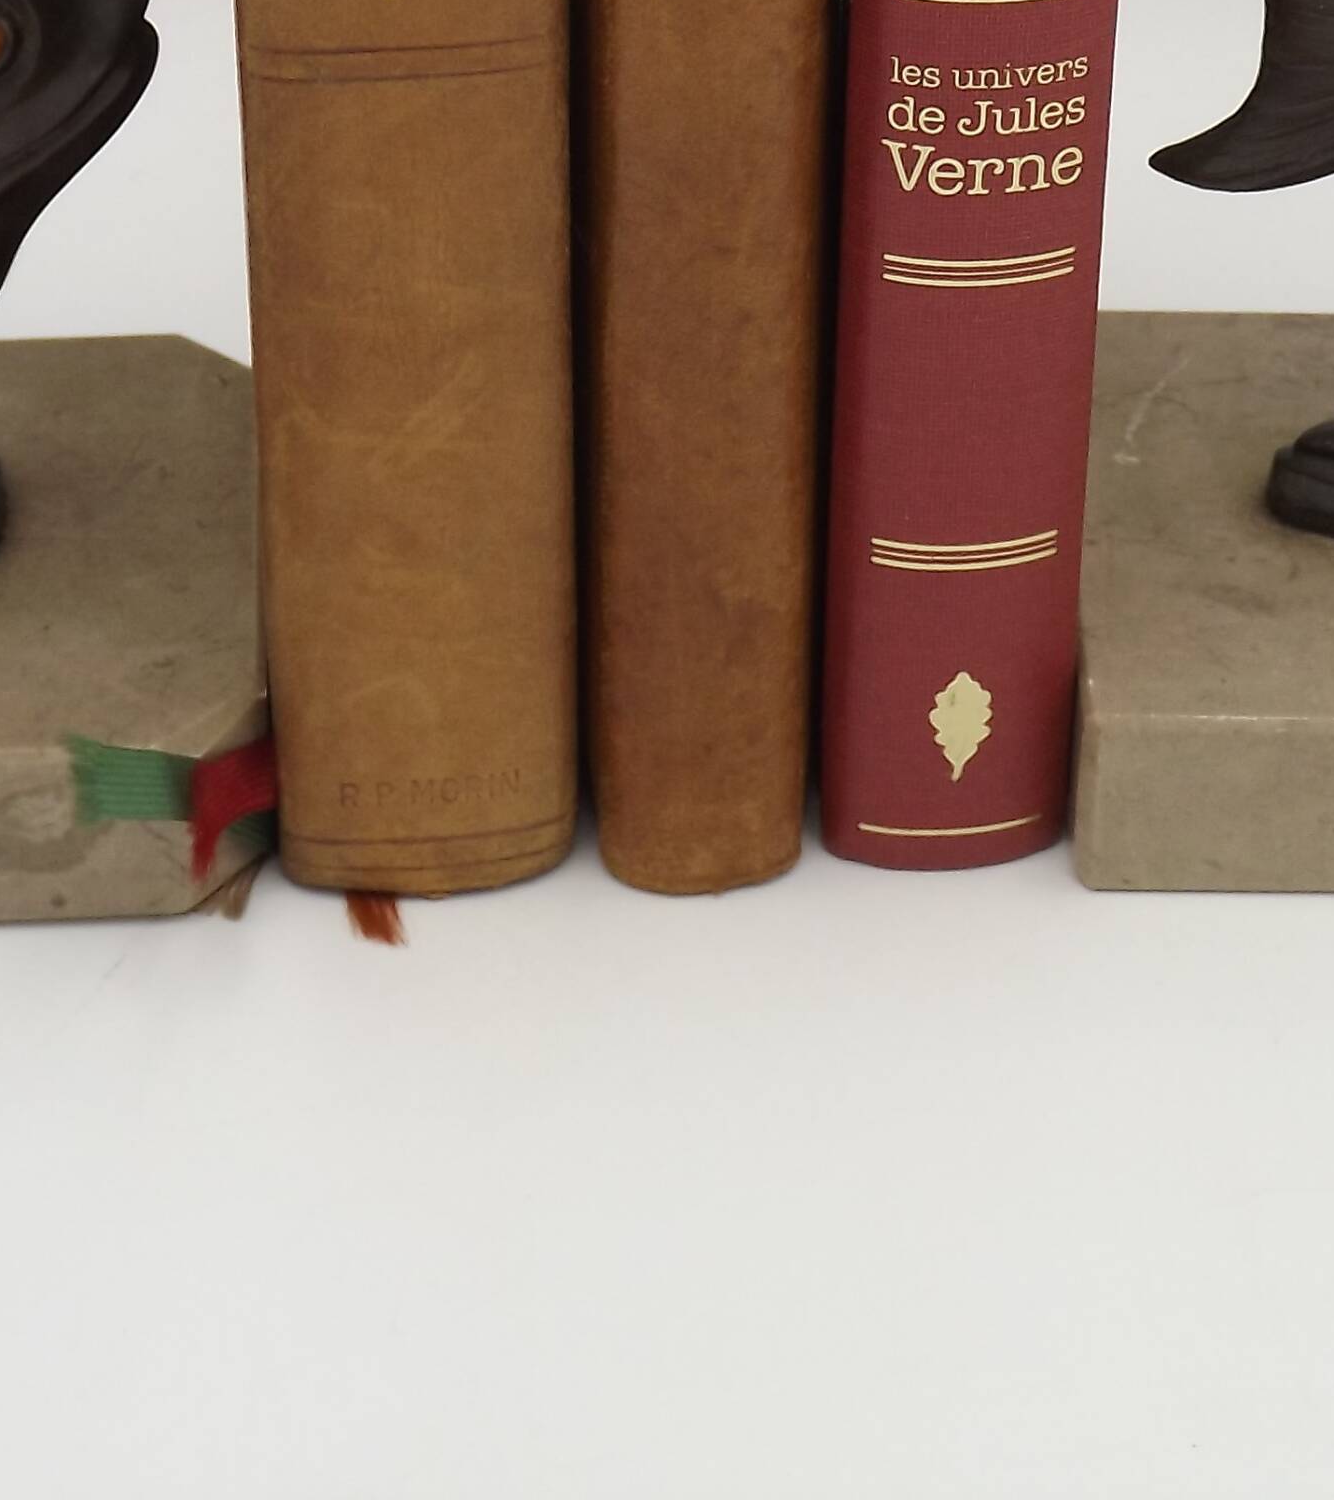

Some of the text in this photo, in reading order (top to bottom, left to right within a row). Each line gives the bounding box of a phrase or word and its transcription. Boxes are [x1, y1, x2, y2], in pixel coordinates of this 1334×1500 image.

[889, 54, 1089, 90] les univers
[886, 95, 1086, 136] de Jules
[881, 138, 1084, 196] Verne
